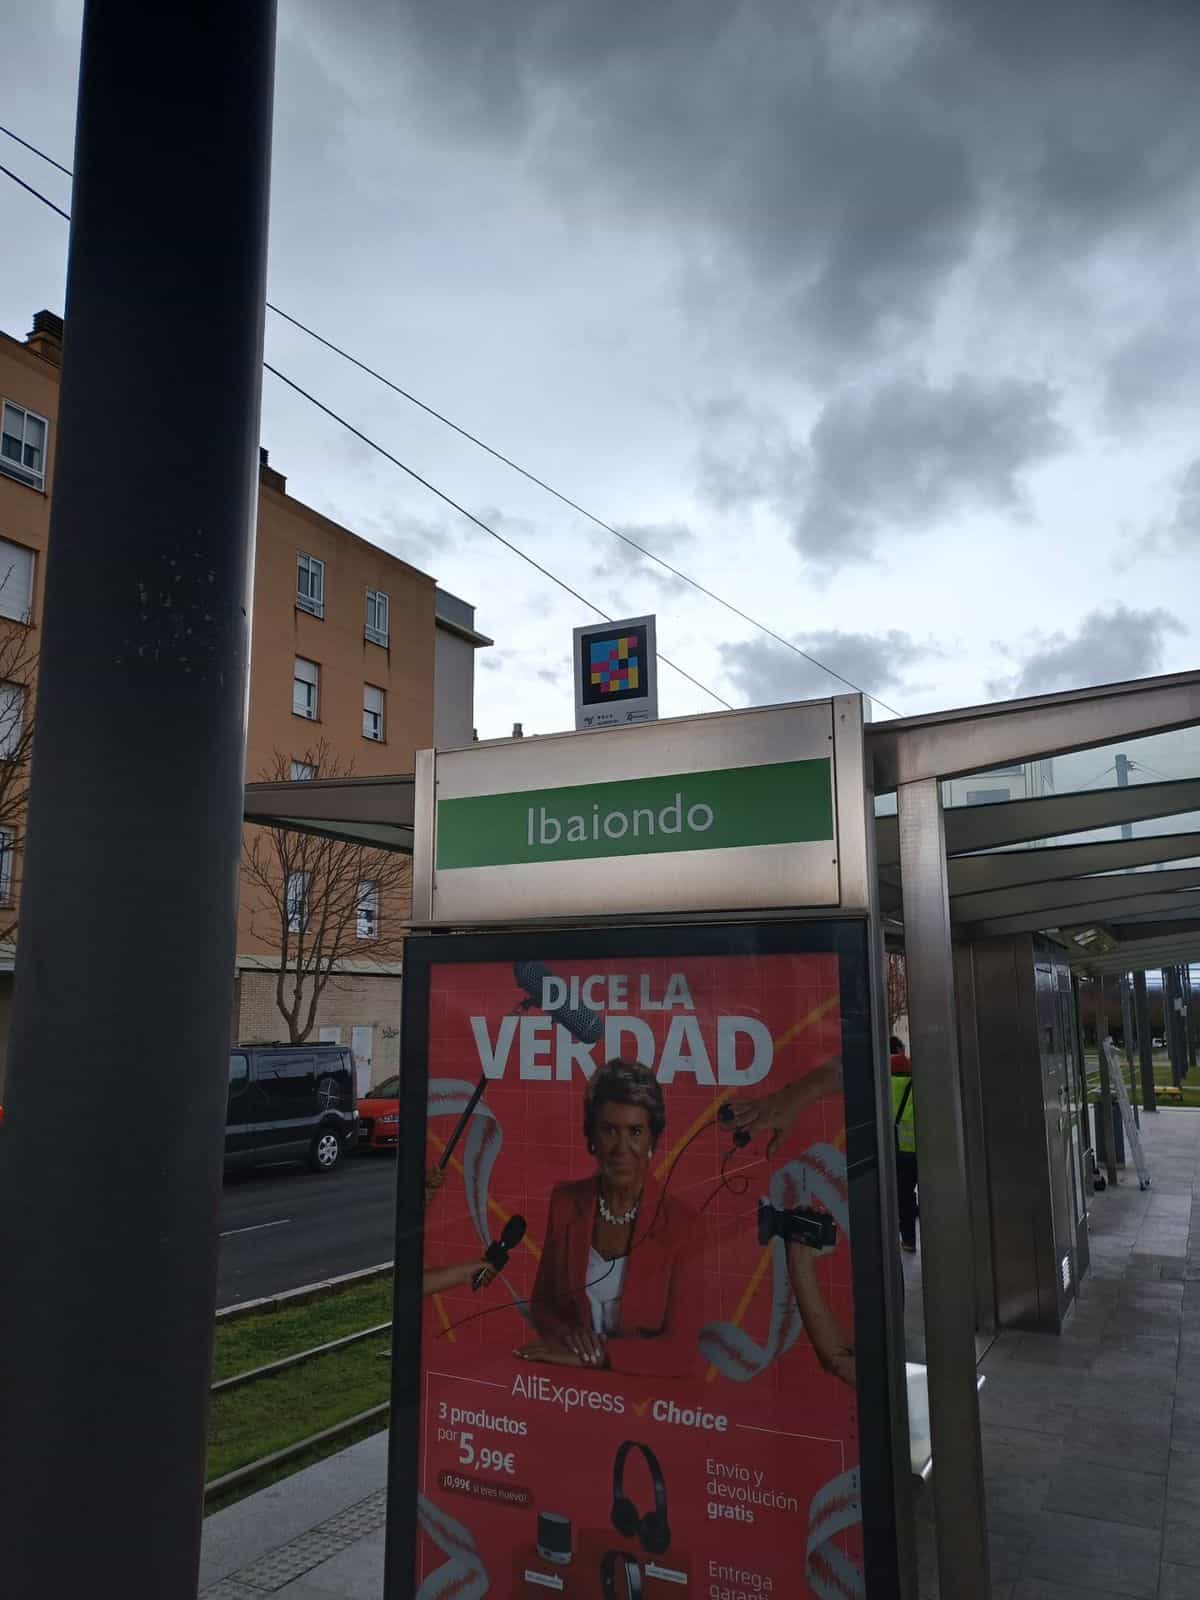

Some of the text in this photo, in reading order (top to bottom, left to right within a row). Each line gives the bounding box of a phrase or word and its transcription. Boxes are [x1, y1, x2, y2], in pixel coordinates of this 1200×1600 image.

[527, 792, 714, 846] Ibaiondo
[541, 973, 695, 1011] DICE LA
[470, 1015, 774, 1086] VERDAD
[439, 1402, 528, 1436] 3 productos
[511, 1373, 728, 1432] AliExpress Choice
[438, 1427, 515, 1474] por 5,99€
[707, 1479, 799, 1513] devolución
[753, 1470, 764, 1487] y
[707, 1502, 754, 1523] gratis
[709, 1560, 773, 1591] Entrega
